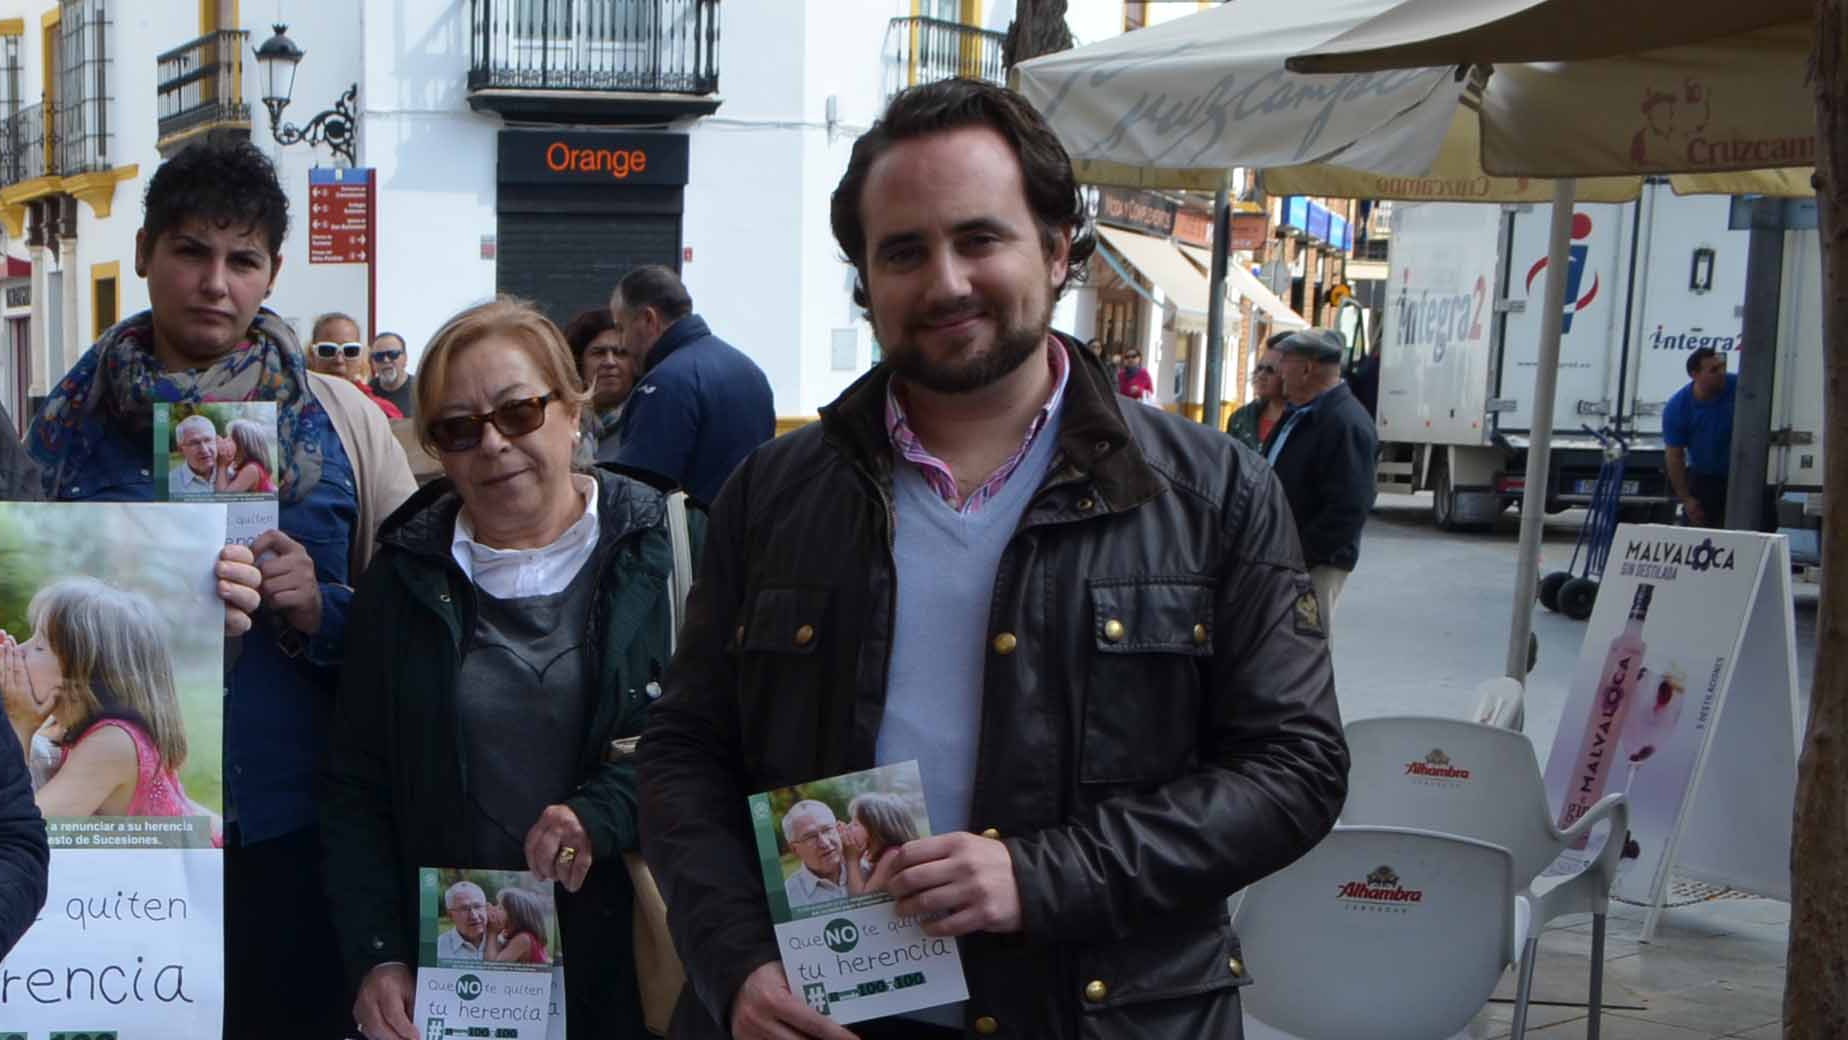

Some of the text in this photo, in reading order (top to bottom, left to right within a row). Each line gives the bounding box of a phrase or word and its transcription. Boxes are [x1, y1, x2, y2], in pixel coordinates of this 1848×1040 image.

[546, 142, 647, 178] Orange
[1687, 136, 1816, 165] Cruzcam
[1624, 538, 1735, 571] MALVALOCA
[1580, 655, 1632, 793] MALVALOCA
[1404, 761, 1470, 779] Alhambra
[48, 836, 73, 845] esto
[76, 835, 90, 845] de
[61, 821, 115, 832] renunciar
[118, 823, 124, 832] a
[128, 823, 142, 832] su
[145, 821, 193, 832] herencia
[1336, 881, 1423, 903] Alhambra
[65, 891, 187, 931] quiten
[788, 933, 824, 951] Que
[825, 925, 858, 945] NO
[863, 923, 880, 938] te
[798, 938, 952, 981] tu herencia
[457, 981, 482, 995] NO
[483, 983, 496, 994] te
[504, 981, 544, 996] quiten
[429, 1002, 542, 1022] tu herencia
